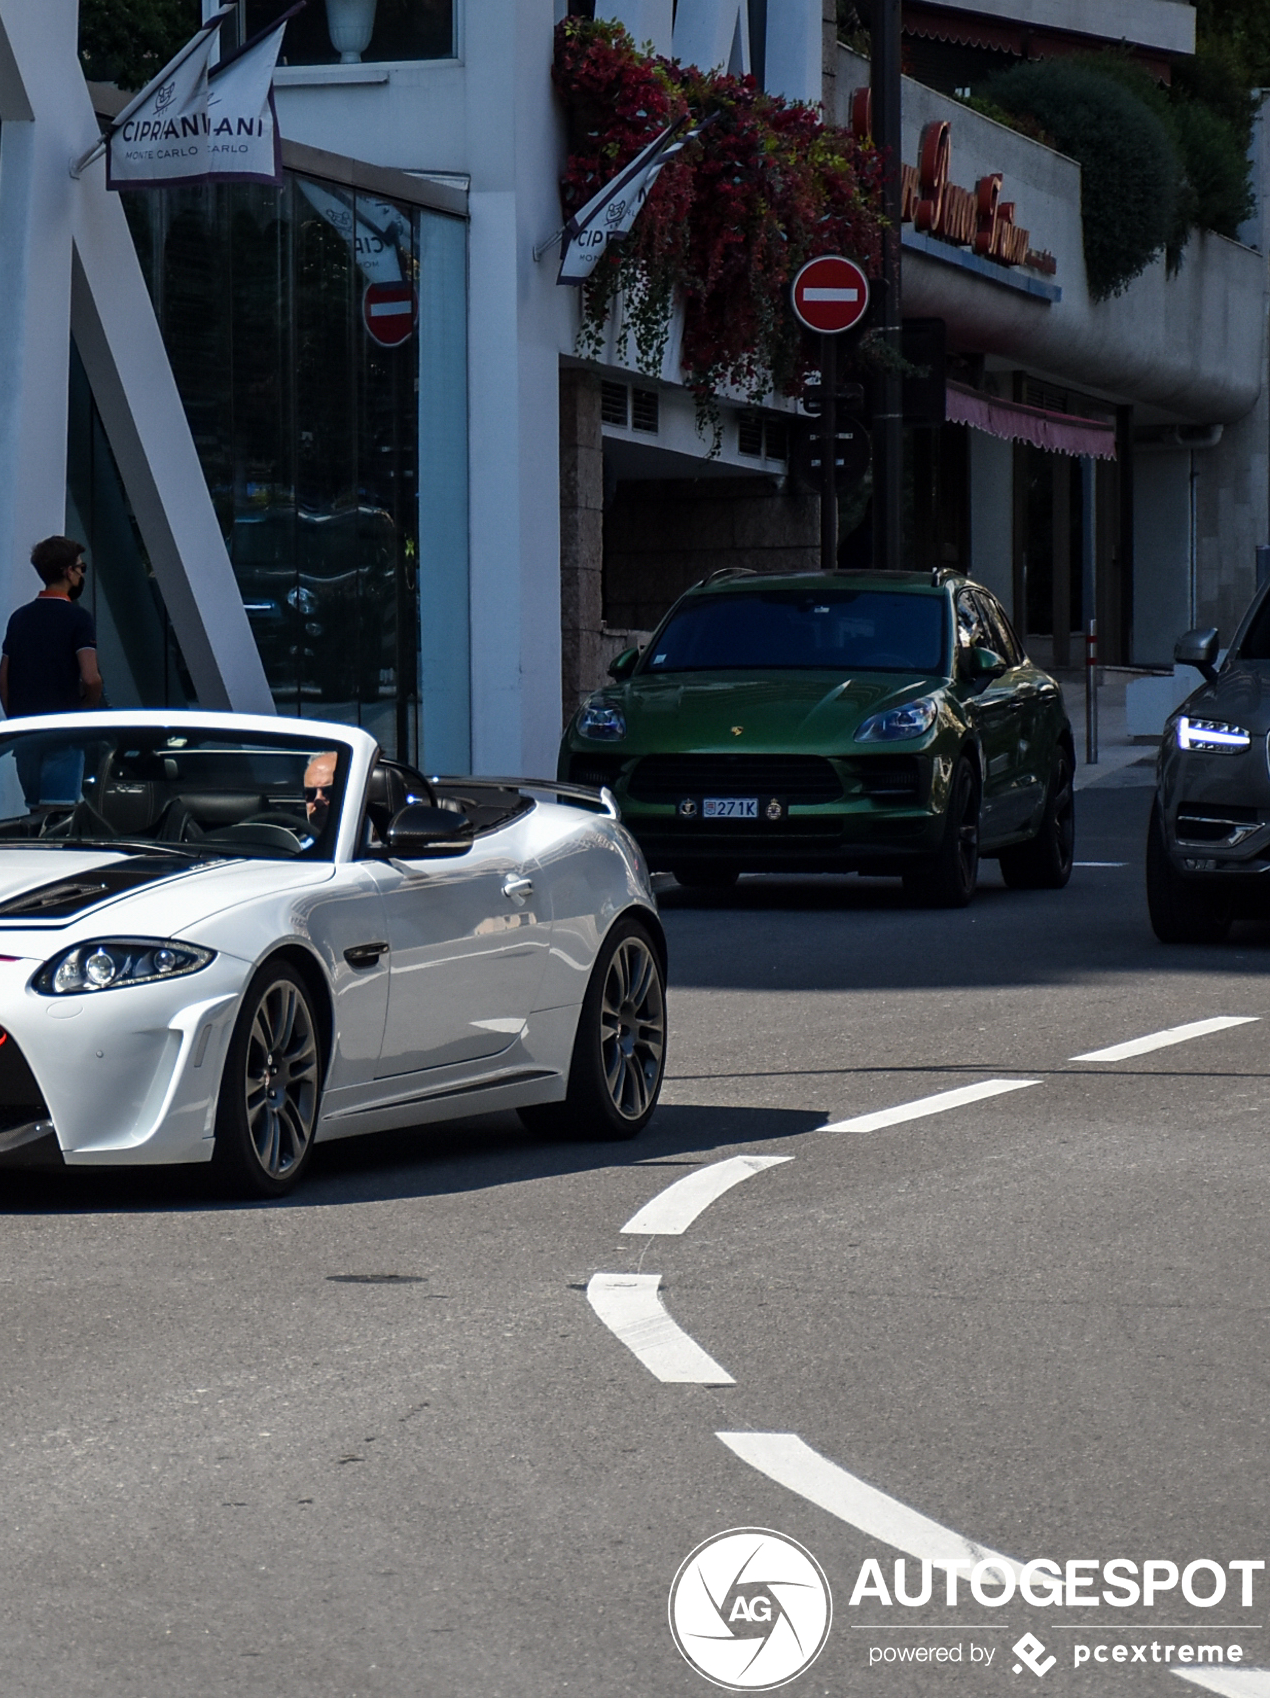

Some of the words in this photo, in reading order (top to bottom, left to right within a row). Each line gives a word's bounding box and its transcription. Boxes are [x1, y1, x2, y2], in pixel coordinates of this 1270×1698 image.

[122, 112, 208, 143] CIPRIANI
[125, 151, 154, 160] MONTE
[157, 146, 199, 160] CARLO
[717, 801, 756, 816] 271K
